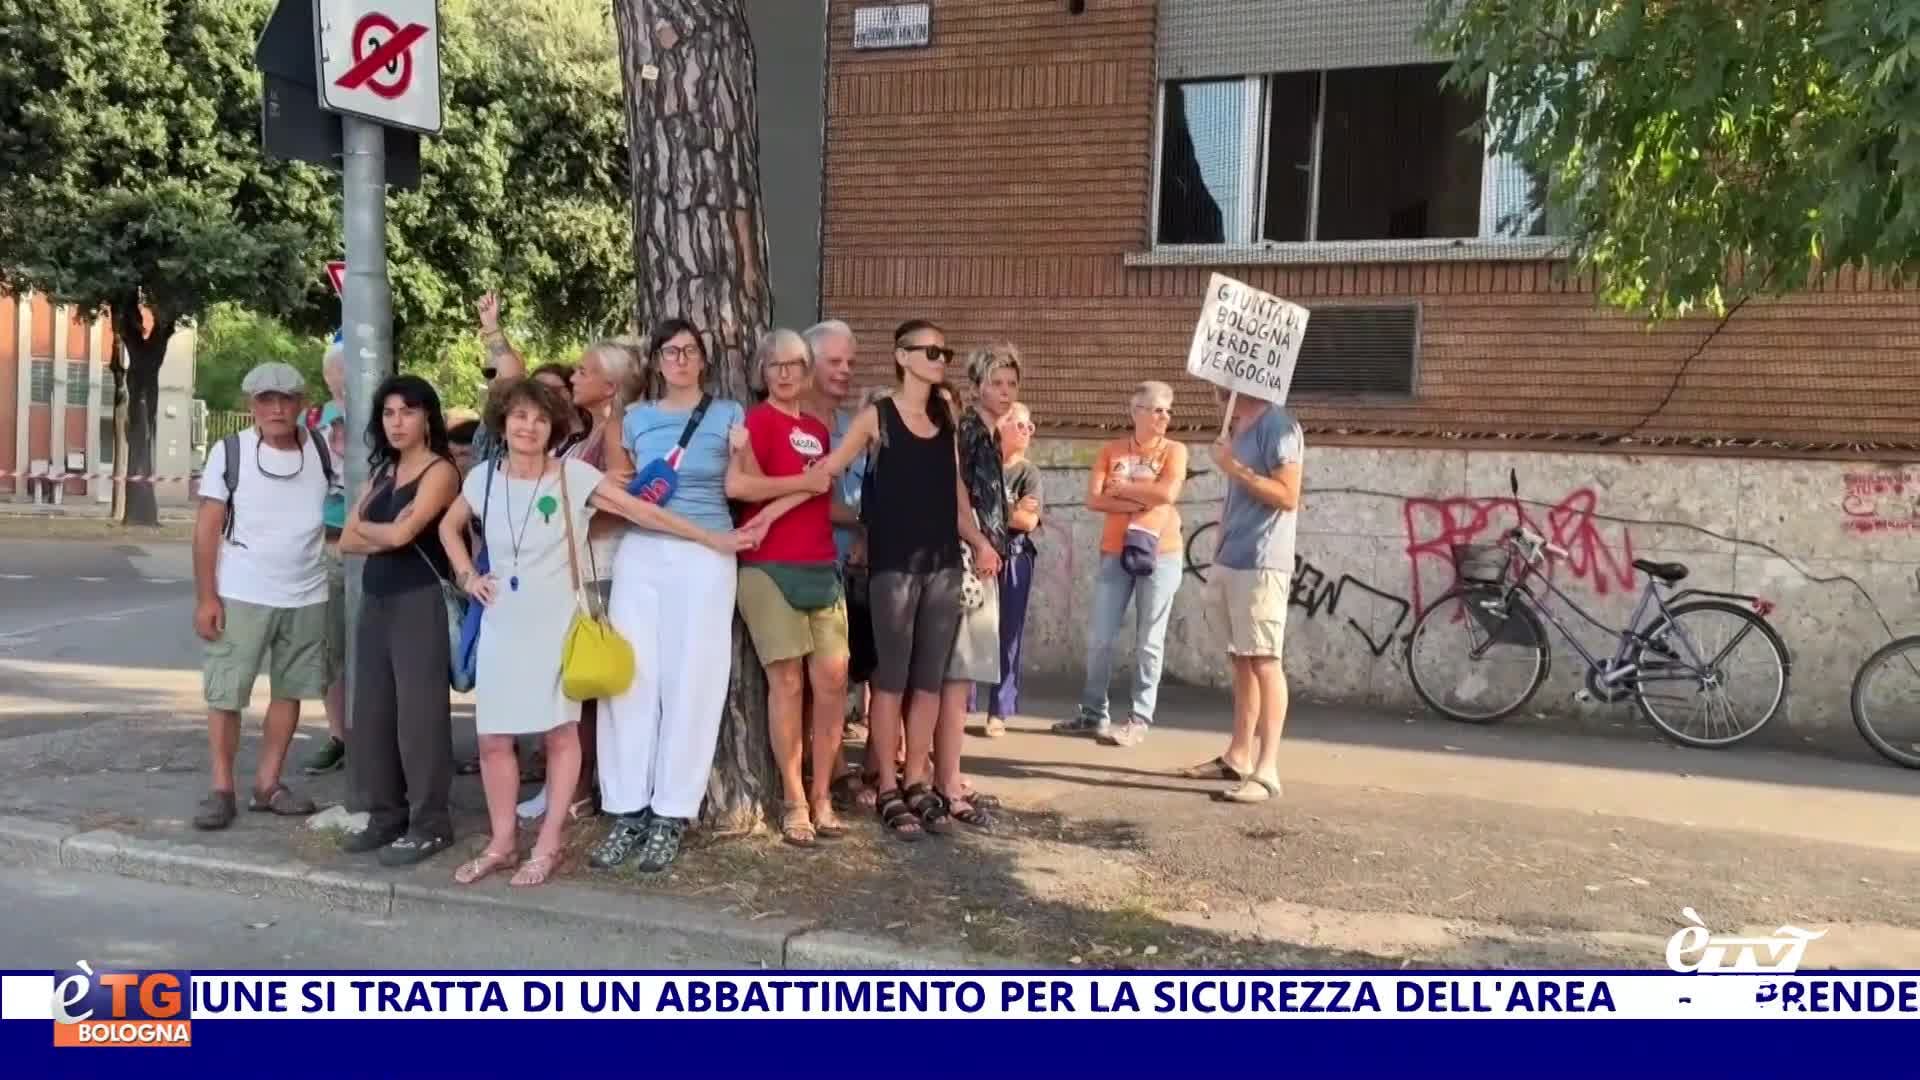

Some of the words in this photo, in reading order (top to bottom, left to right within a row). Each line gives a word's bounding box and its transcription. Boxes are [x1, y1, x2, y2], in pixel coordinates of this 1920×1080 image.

[1216, 306, 1291, 350] BOLOGNA
[1217, 283, 1282, 324] GIUNTA
[1286, 309, 1299, 330] DI
[1200, 346, 1282, 392] VERGOGNA
[1207, 327, 1263, 360] VERDE
[1267, 349, 1282, 369] DI
